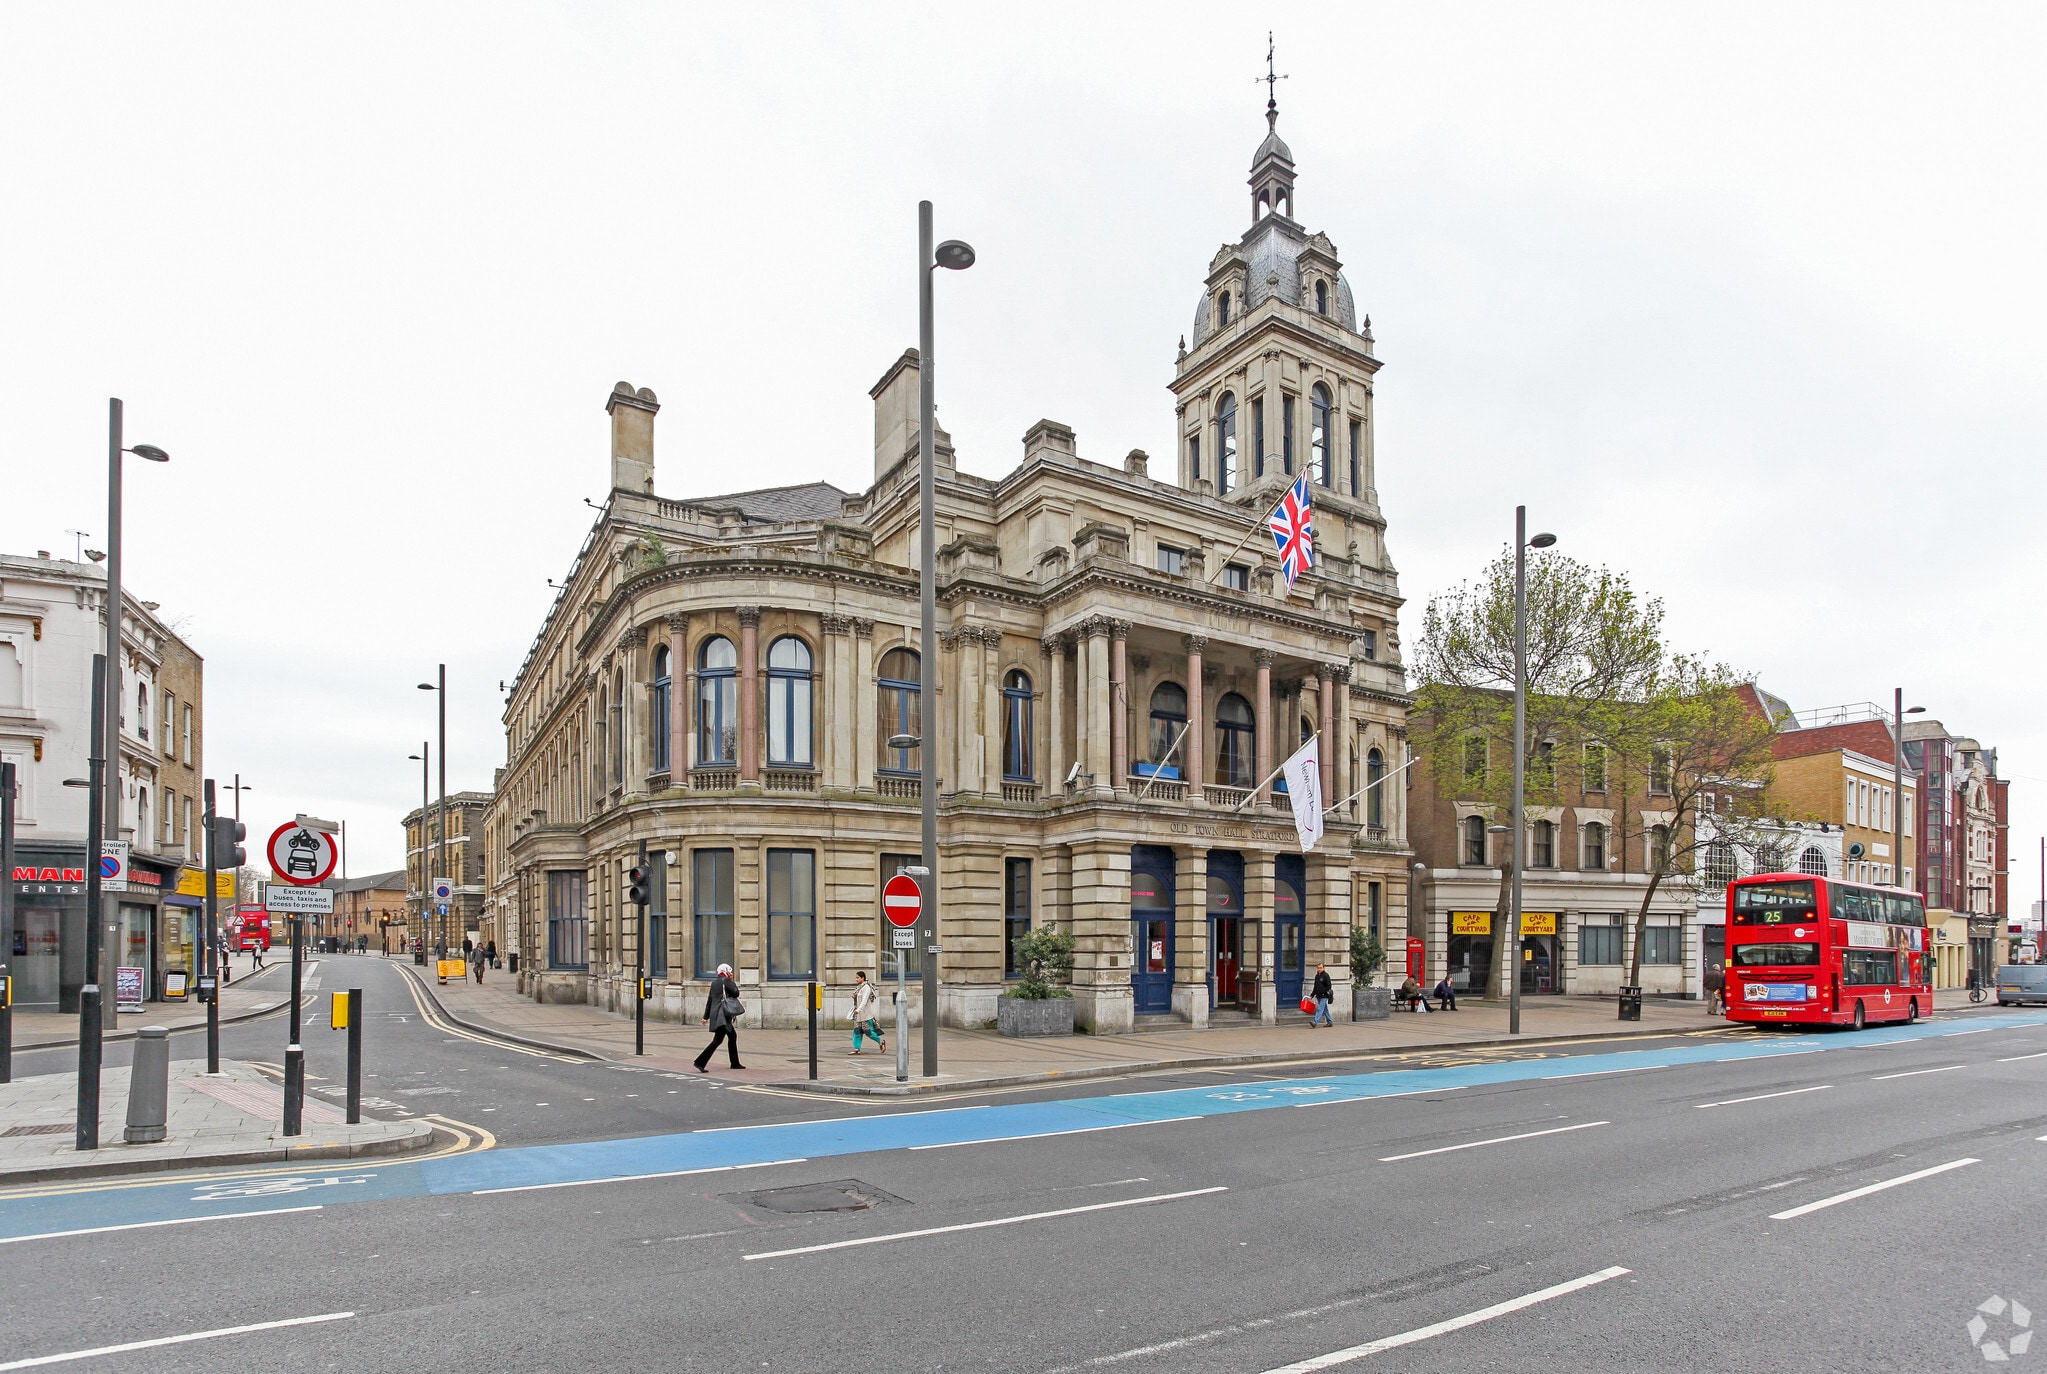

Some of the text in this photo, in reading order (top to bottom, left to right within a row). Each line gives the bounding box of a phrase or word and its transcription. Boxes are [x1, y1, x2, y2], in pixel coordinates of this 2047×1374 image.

[1170, 823, 1188, 833] OLD
[1195, 825, 1219, 836] TOWN
[1251, 830, 1295, 841] STRATFORD
[283, 888, 307, 896] Except
[1463, 914, 1481, 923] CAFE
[1529, 914, 1548, 924] CAFE
[1765, 911, 1781, 922] 25
[1456, 925, 1488, 933] COURTYARD
[894, 930, 914, 938] Except
